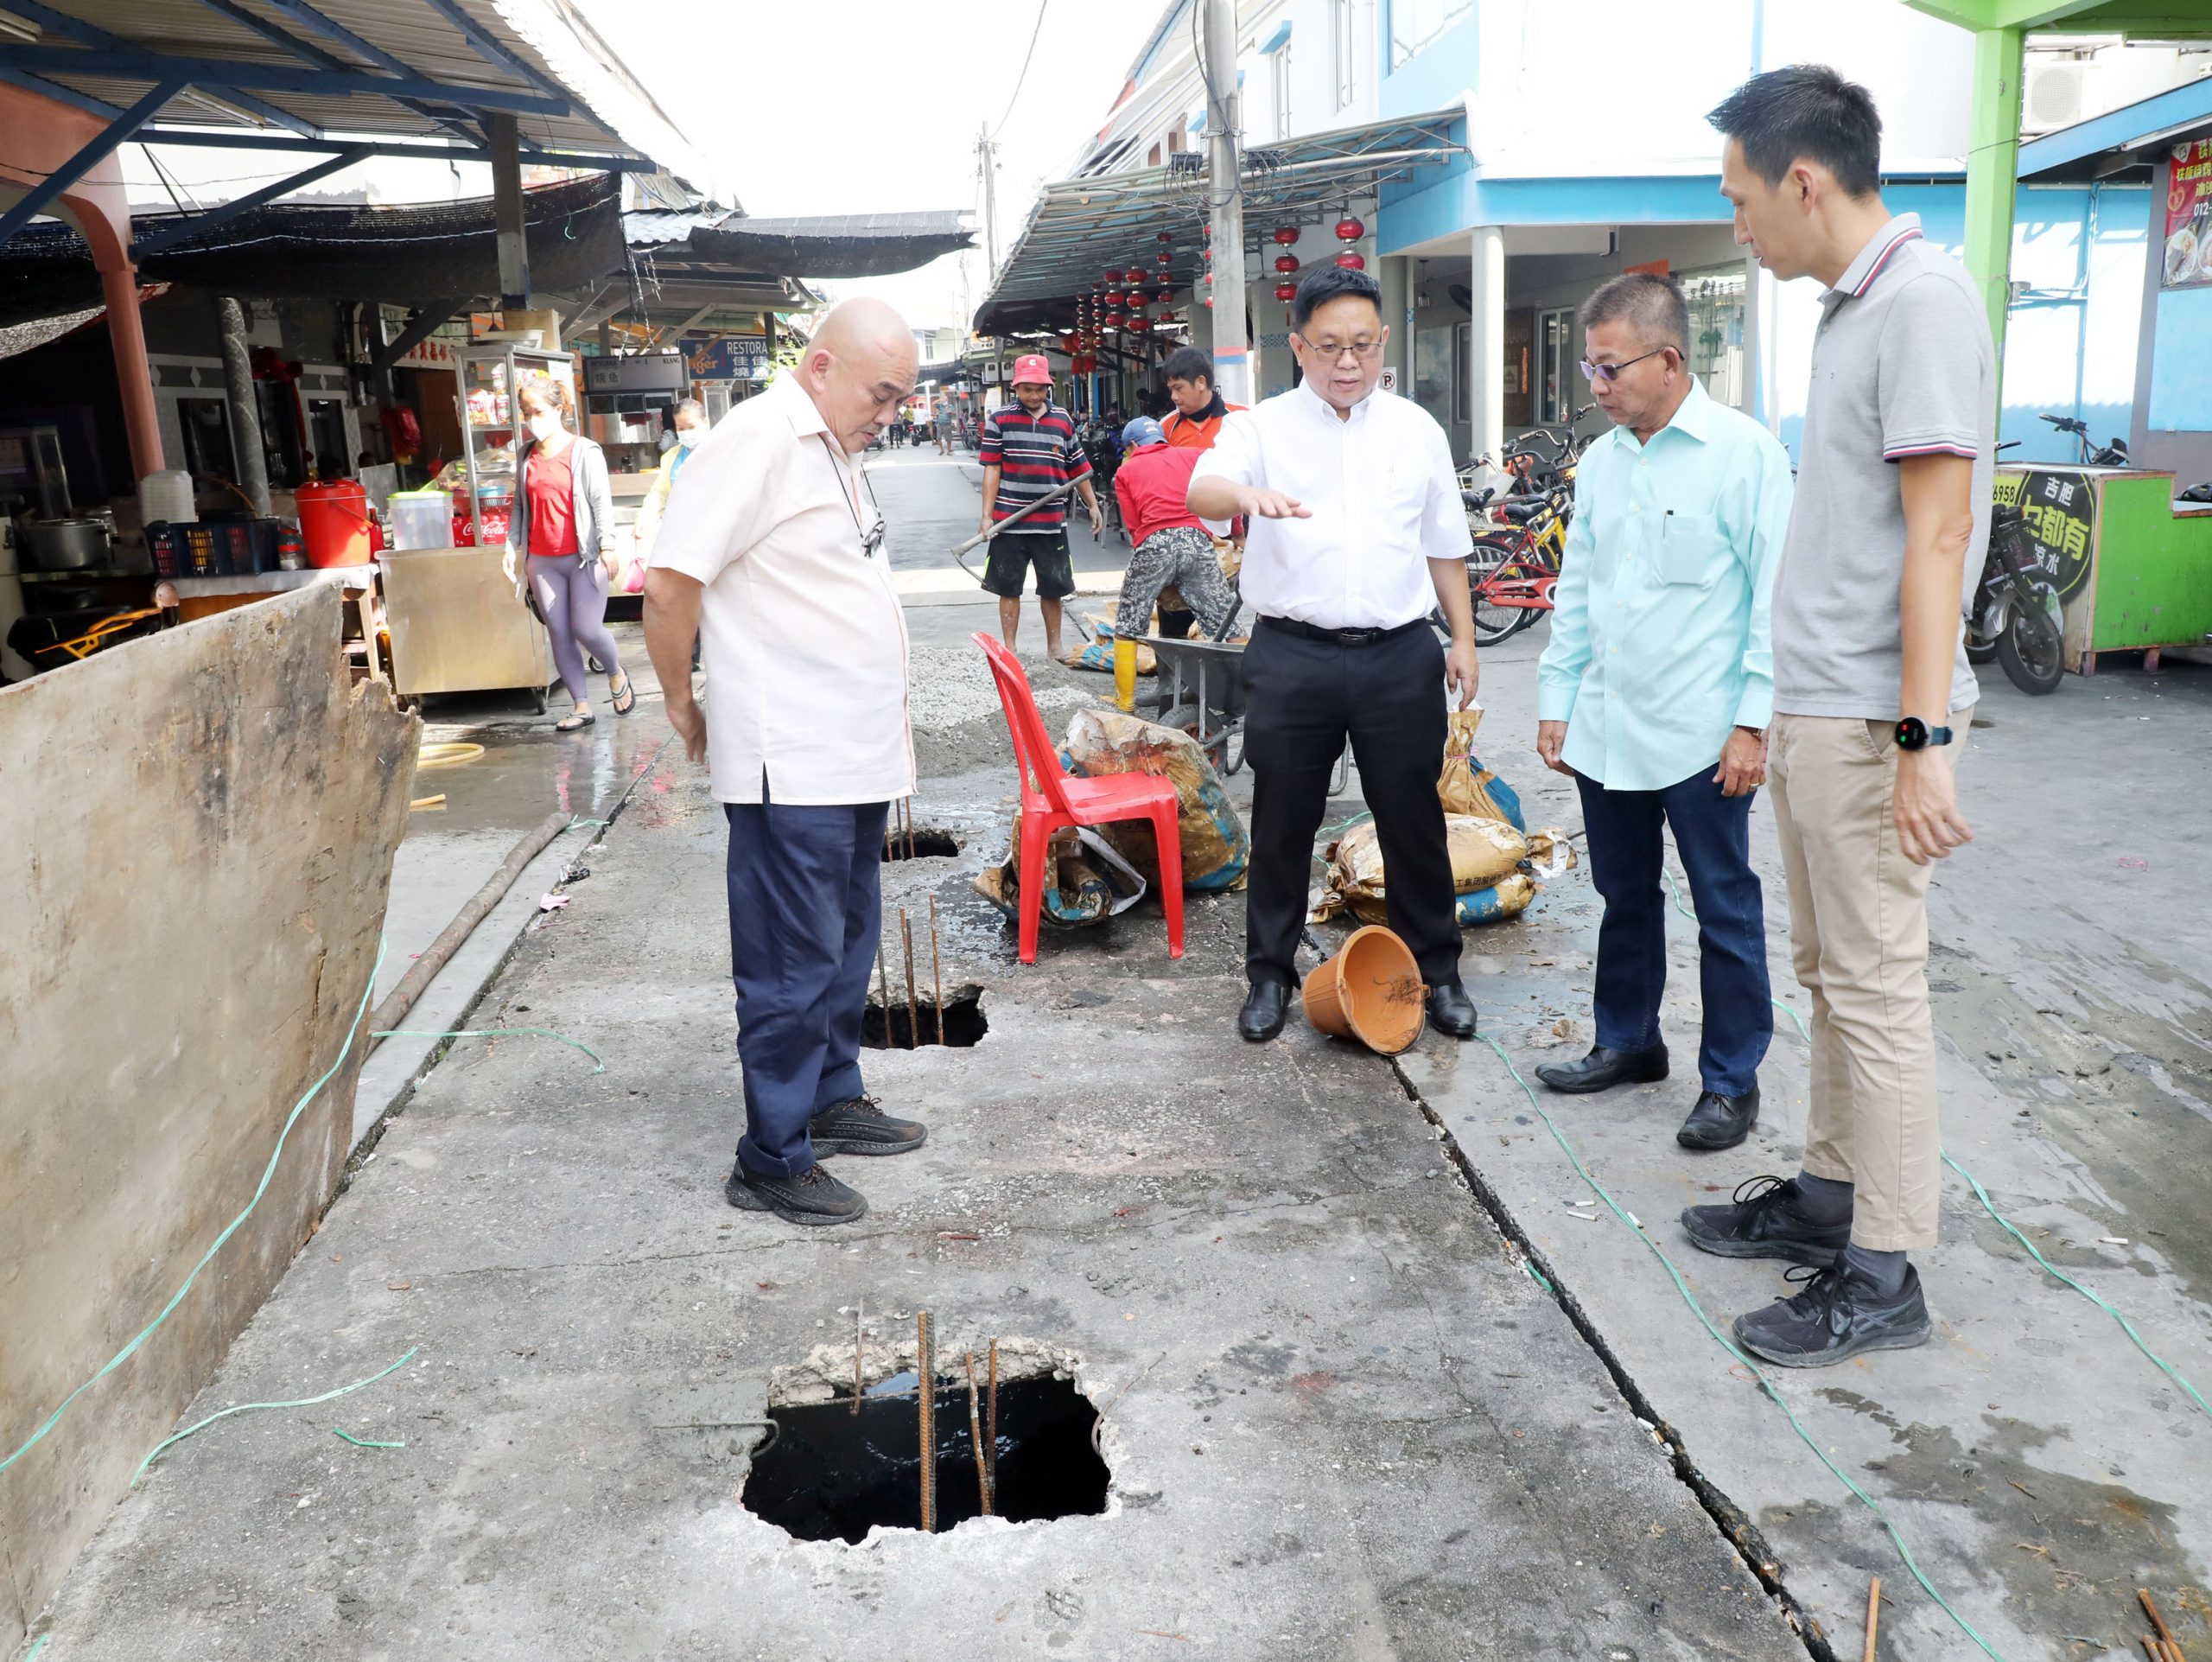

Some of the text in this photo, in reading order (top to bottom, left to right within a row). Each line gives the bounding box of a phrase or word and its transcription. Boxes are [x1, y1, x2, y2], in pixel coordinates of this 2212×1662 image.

[2198, 137, 2212, 159] 铁
[1993, 484, 2015, 503] 6958
[2044, 476, 2075, 506] 吉胆
